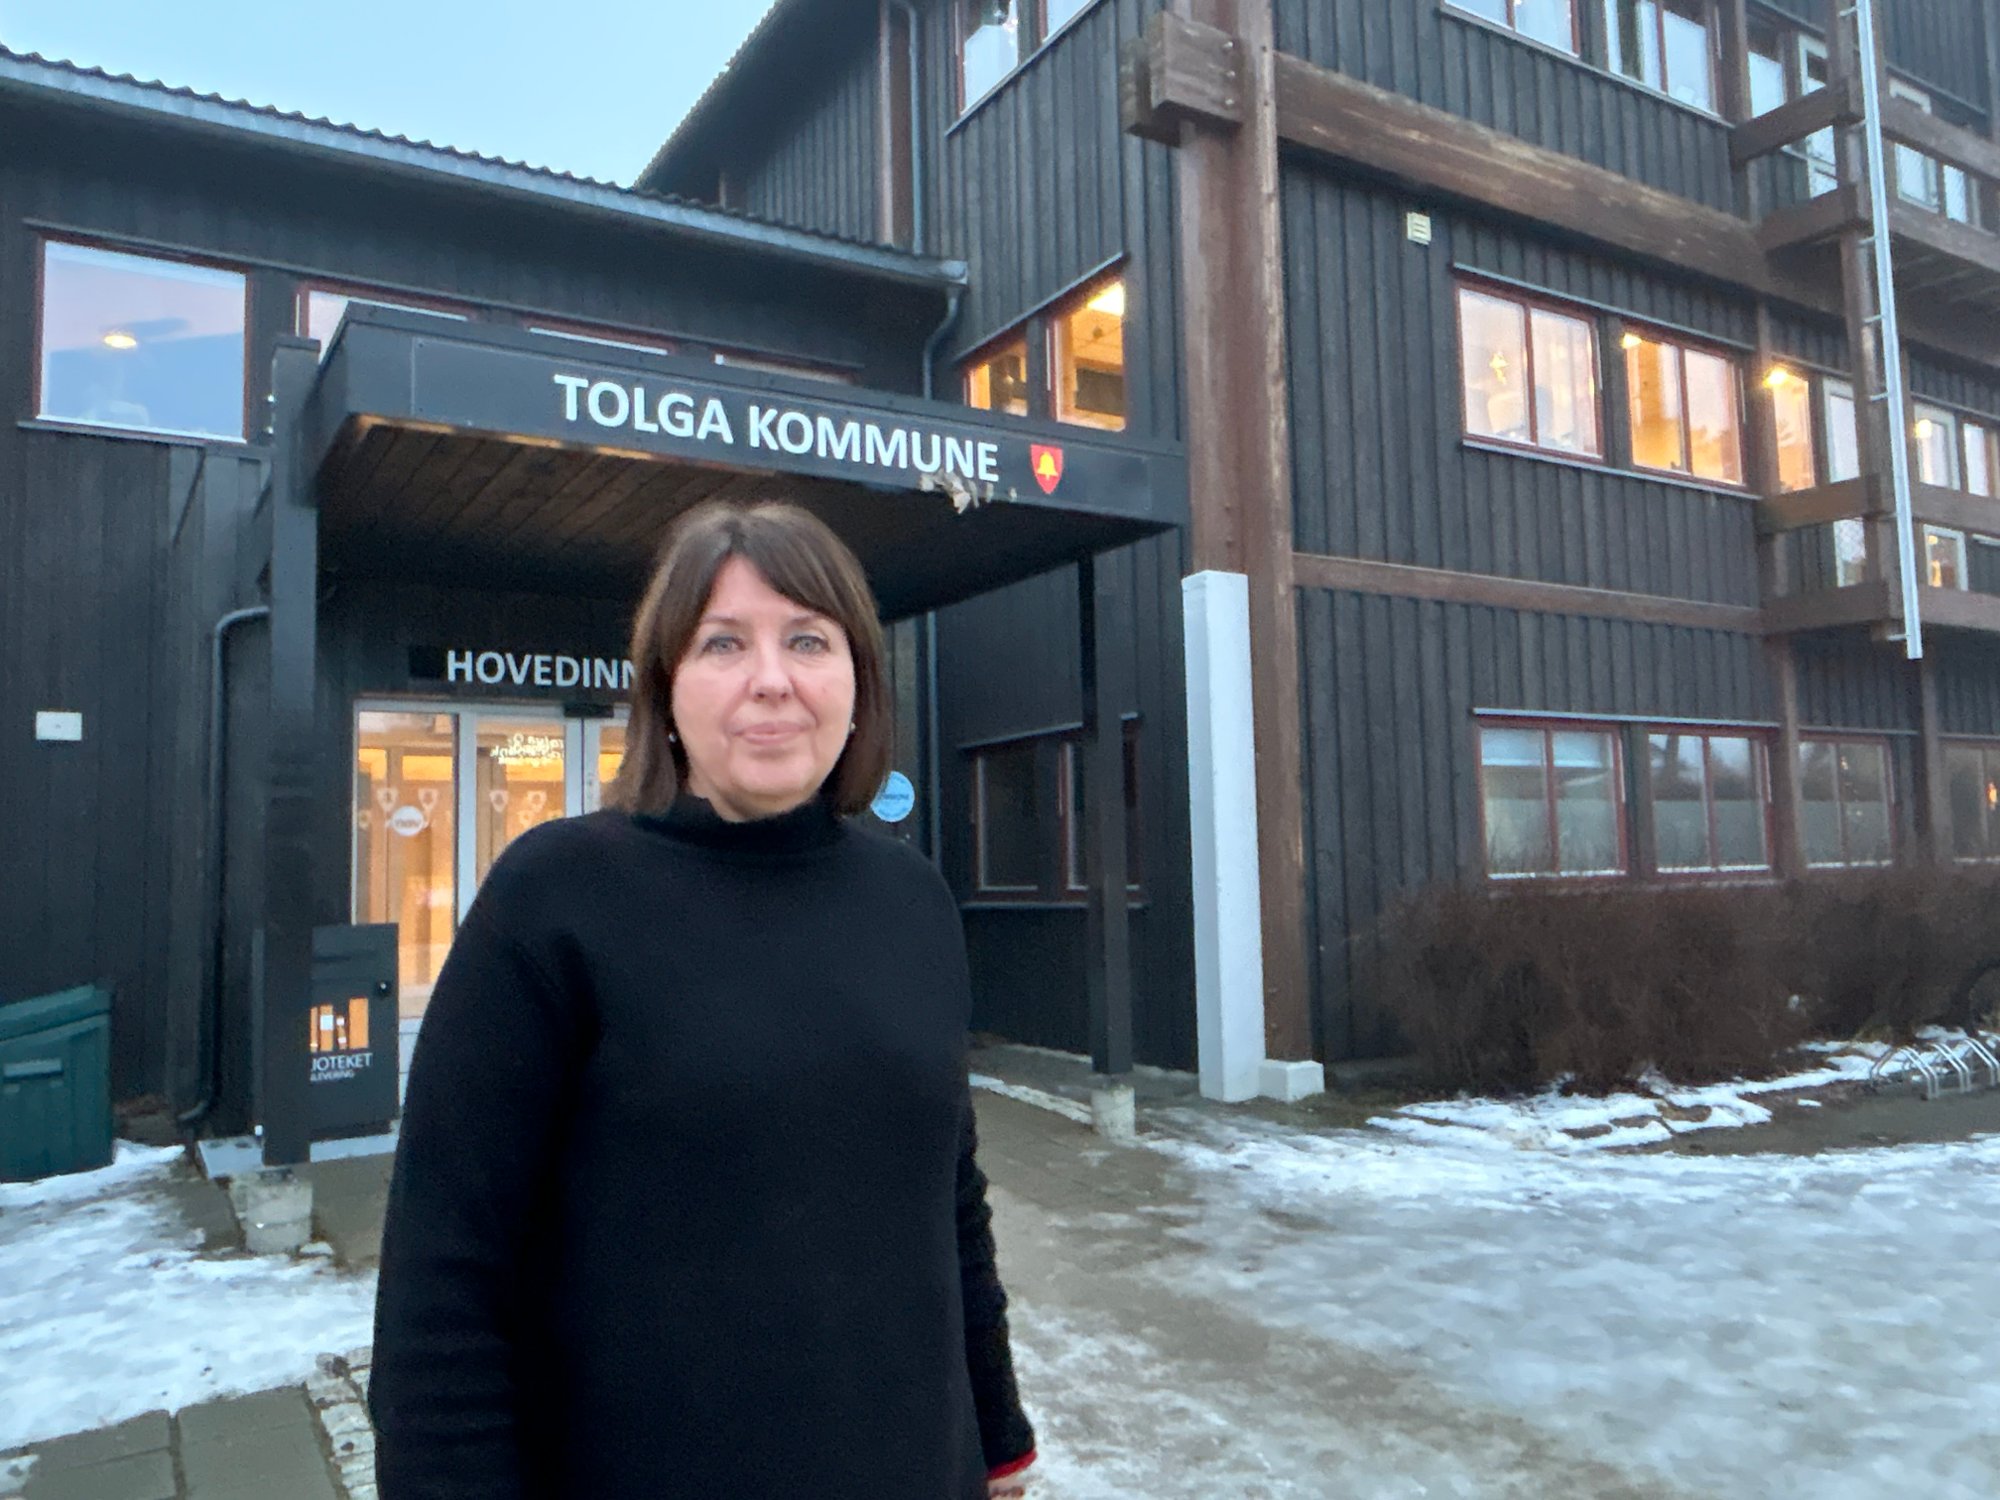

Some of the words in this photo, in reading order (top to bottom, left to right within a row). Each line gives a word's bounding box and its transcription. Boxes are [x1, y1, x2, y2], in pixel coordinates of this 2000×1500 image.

[554, 374, 734, 445] TOLGA
[748, 405, 999, 482] KOMMUNE
[447, 650, 637, 689] HOVEDINN
[311, 1053, 373, 1072] IOTEKET
